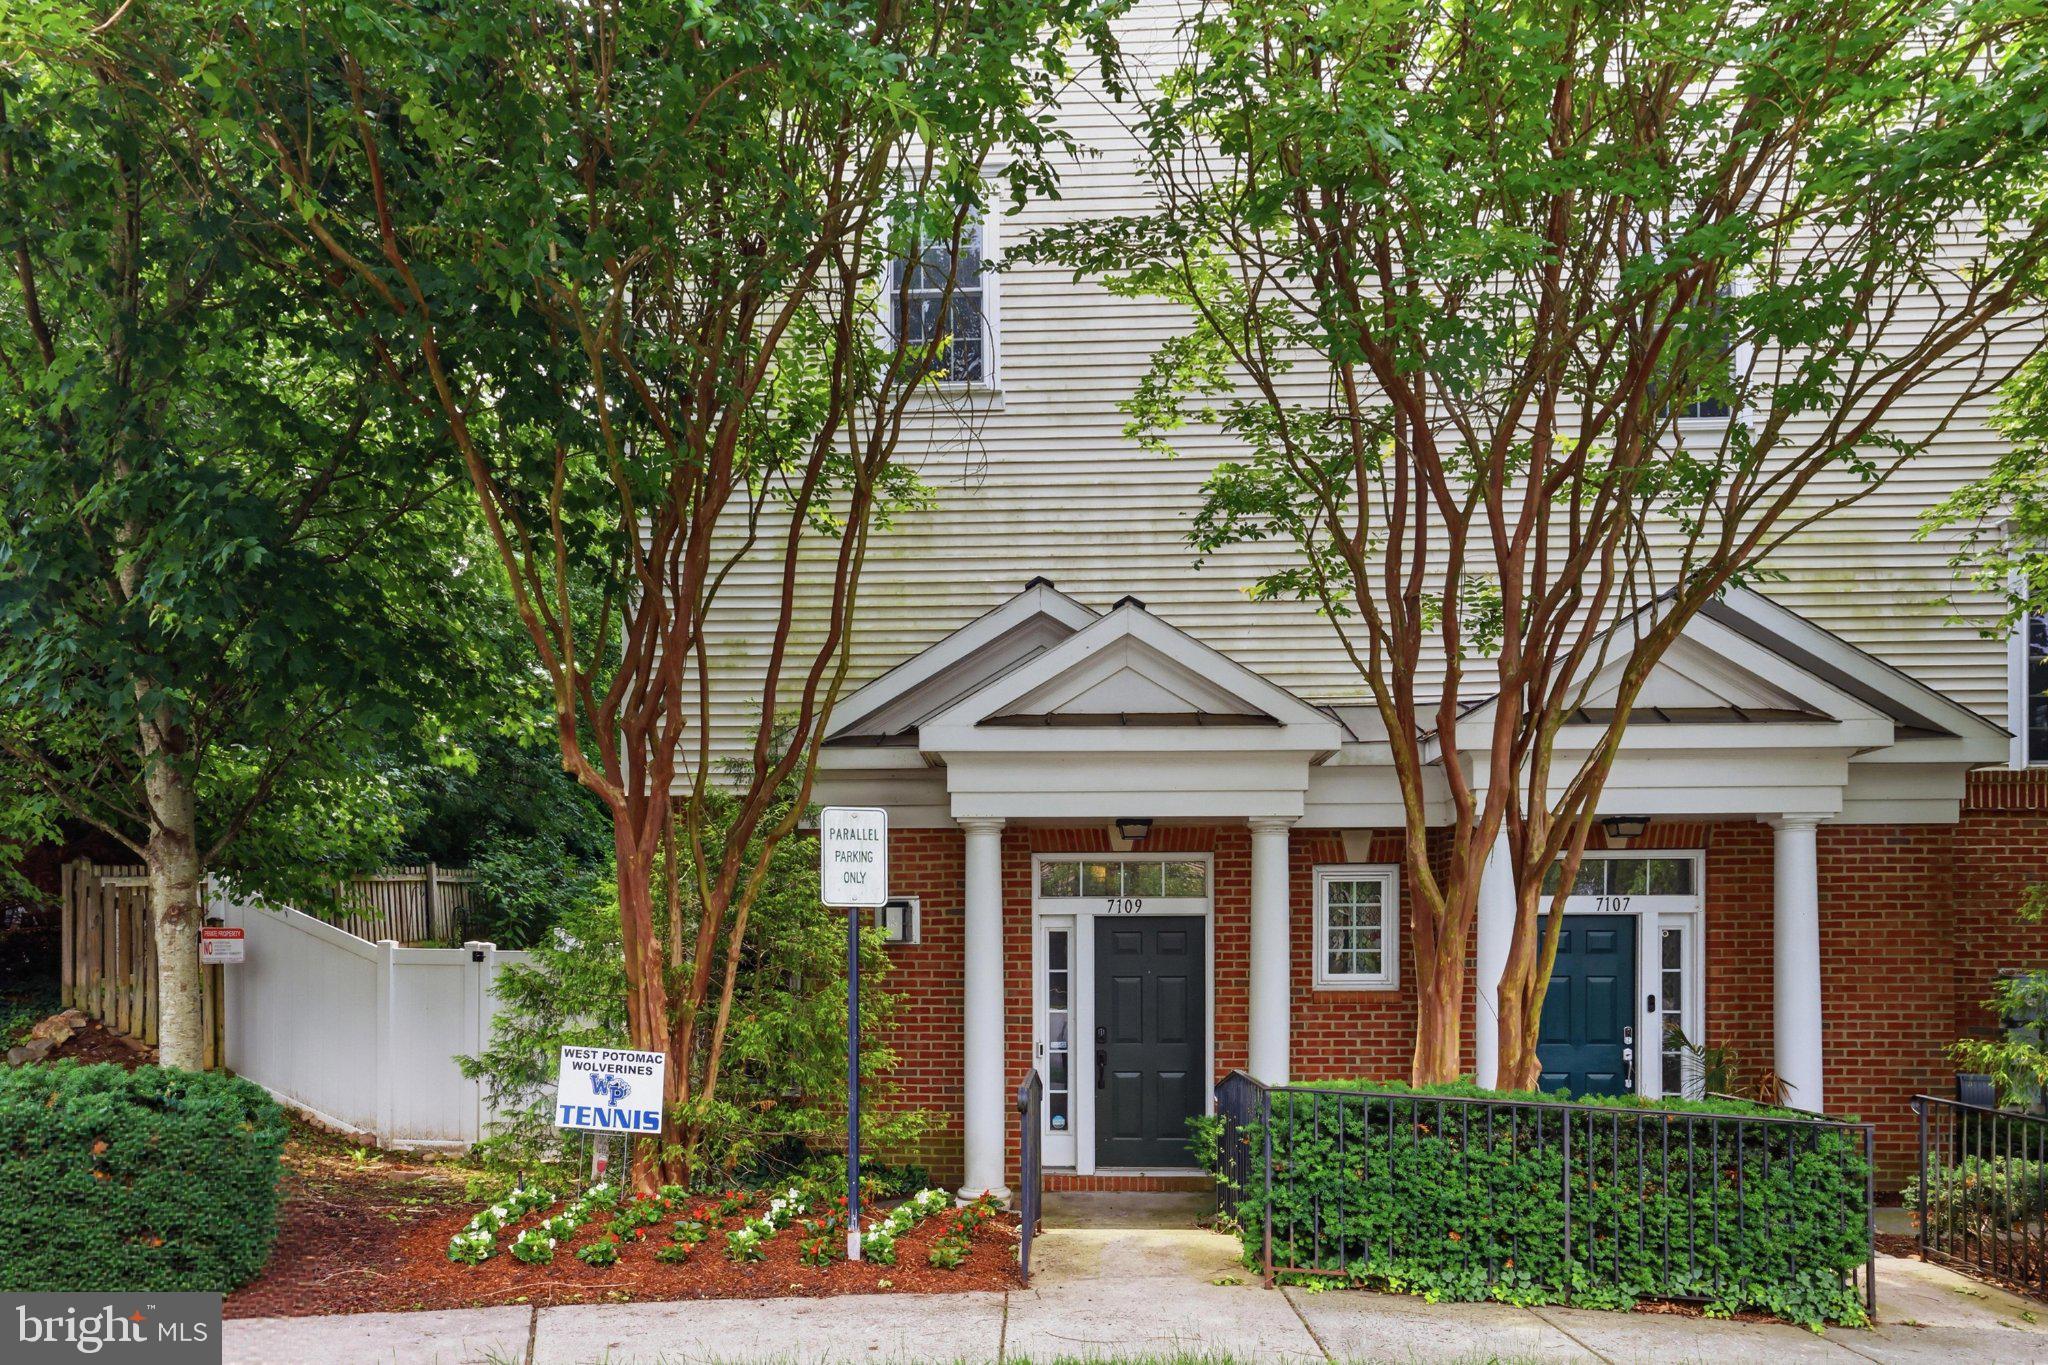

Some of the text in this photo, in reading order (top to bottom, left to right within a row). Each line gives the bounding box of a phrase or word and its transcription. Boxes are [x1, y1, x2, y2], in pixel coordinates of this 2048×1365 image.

[829, 828, 879, 841] PARALLEL
[835, 850, 873, 863] PARKING
[843, 871, 867, 884] ONLY
[1107, 899, 1142, 914] 7109
[1596, 897, 1630, 911] 7107
[203, 941, 213, 955] NO
[564, 1048, 663, 1064] WEST POTOMAC
[572, 1061, 653, 1076] WOLVERINES
[559, 1104, 660, 1131] TENNIS
